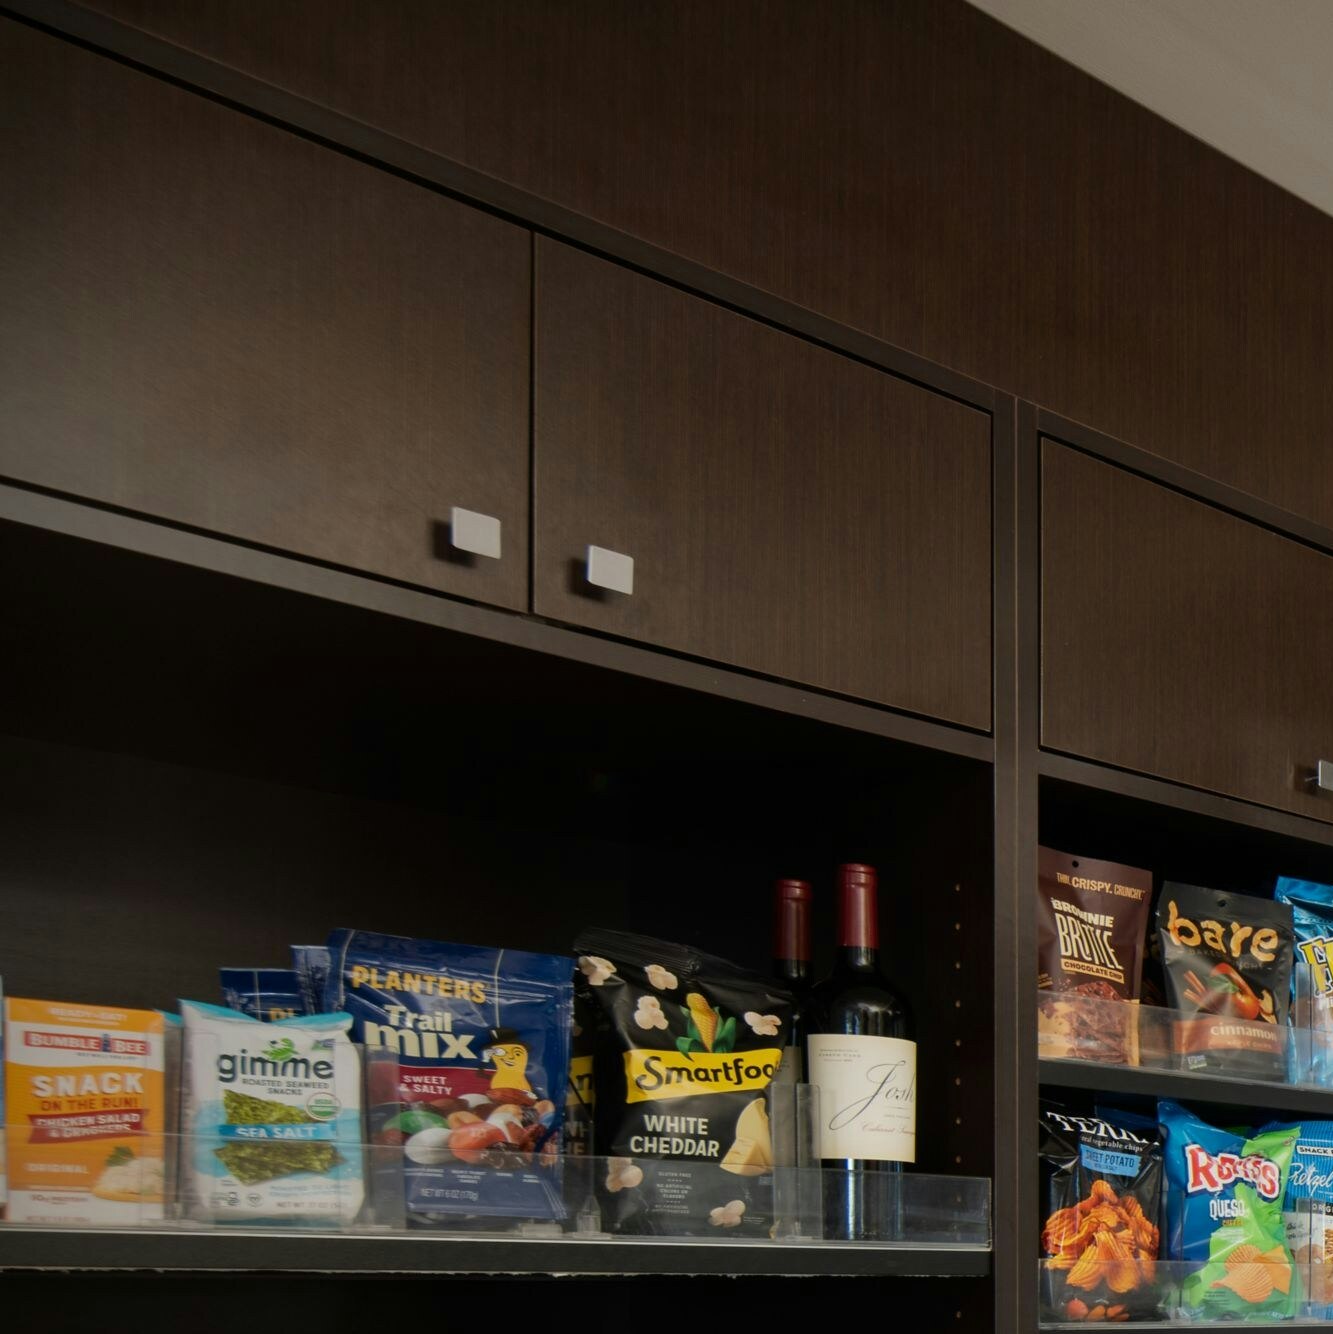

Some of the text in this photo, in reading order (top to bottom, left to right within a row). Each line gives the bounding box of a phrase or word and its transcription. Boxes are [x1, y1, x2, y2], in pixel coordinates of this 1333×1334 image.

[1051, 897, 1113, 927] BROWNIE
[1055, 912, 1124, 970] BRITTLE
[1168, 900, 1279, 962] bare
[352, 965, 486, 1004] PLANTERS
[385, 1004, 451, 1033] Trail
[29, 1032, 147, 1055] BUMBLE BEE
[364, 1020, 478, 1060] mix
[1210, 1023, 1277, 1042] cinnamon
[218, 1049, 334, 1083] gimme
[31, 1072, 144, 1097] SNACK
[242, 1078, 329, 1089] ROASTED SEAWEED
[403, 1074, 447, 1086] SWEET
[412, 1083, 452, 1096] SALTY
[643, 1115, 708, 1136] WHITE
[630, 1136, 719, 1158] CHEDDAR
[1300, 1147, 1329, 1156] SNACK
[1104, 1154, 1134, 1167] POTATO
[1209, 1199, 1245, 1220] QUESO
